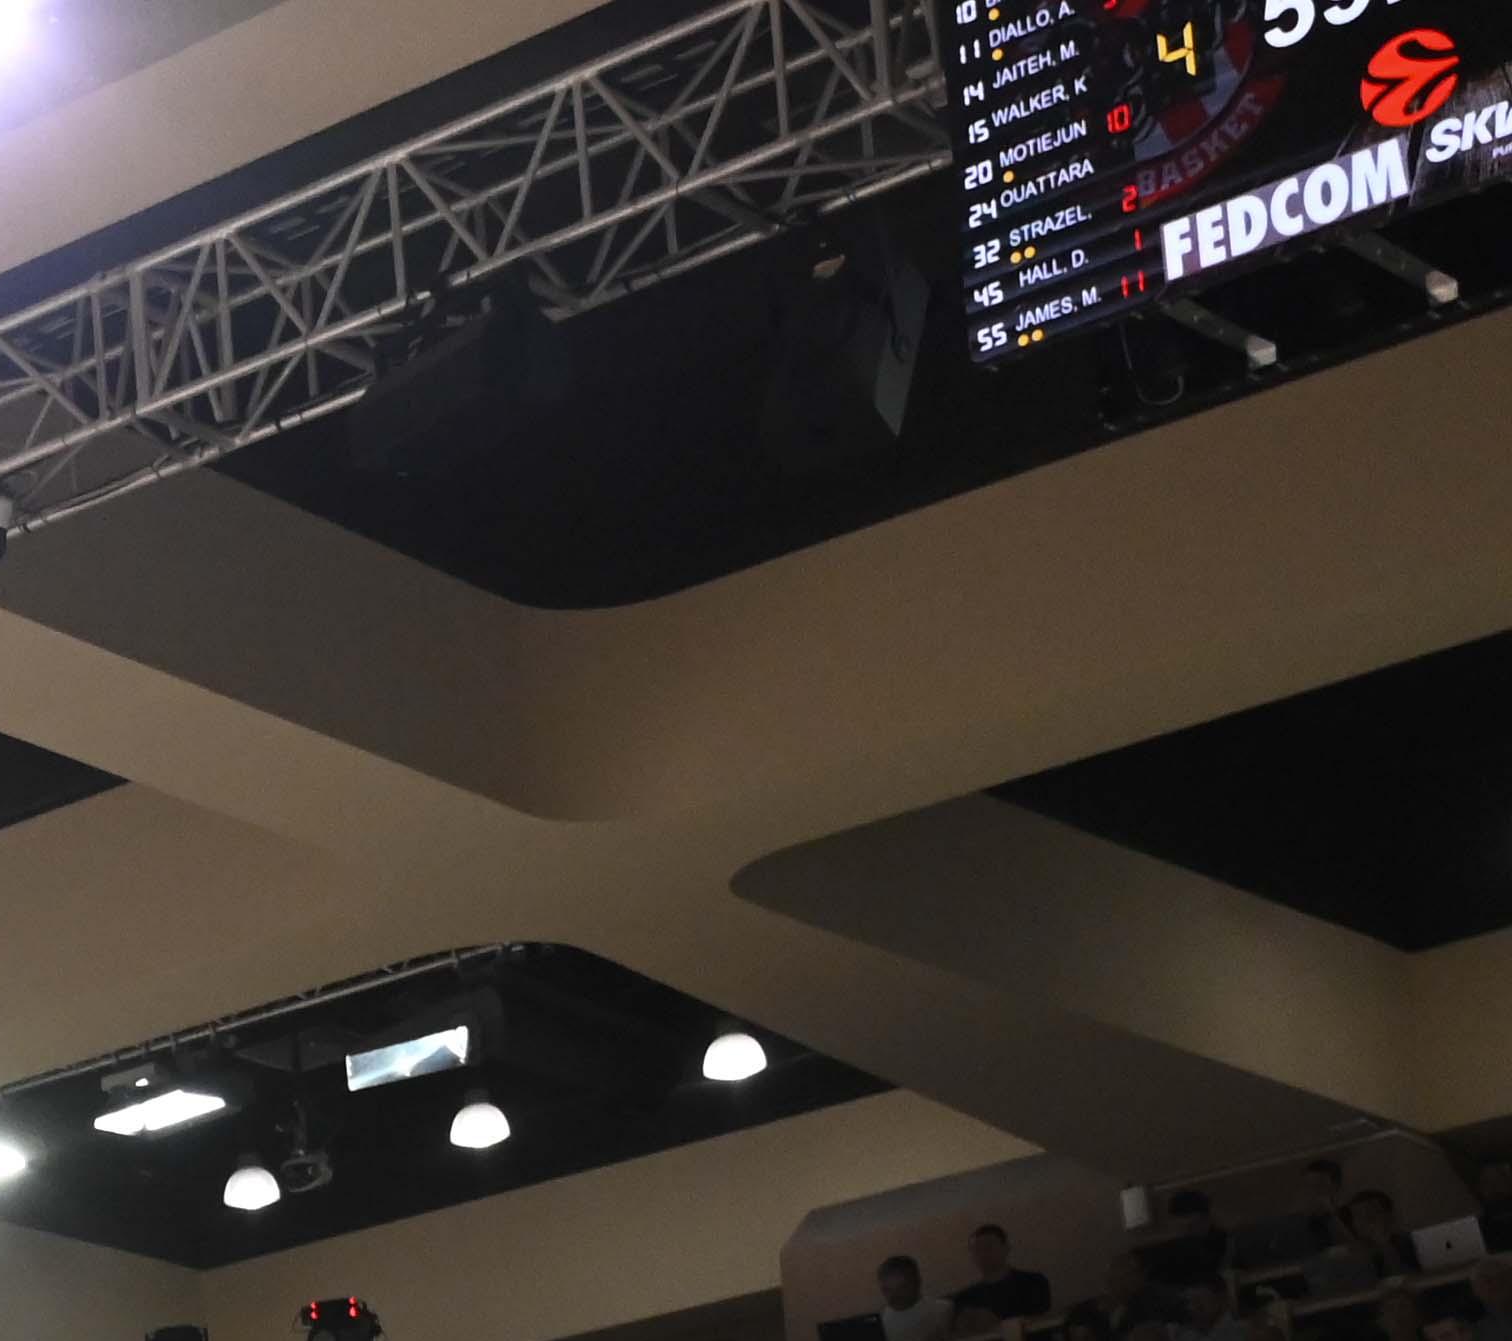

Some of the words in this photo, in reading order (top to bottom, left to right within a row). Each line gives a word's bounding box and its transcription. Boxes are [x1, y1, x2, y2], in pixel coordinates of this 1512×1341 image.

[1157, 21, 1196, 76] 4
[963, 80, 985, 106] 14
[968, 119, 990, 144] 15
[964, 159, 993, 190] 20
[999, 120, 1088, 168] MOTIEJUN
[968, 199, 998, 229] 24
[1000, 158, 1095, 208] OUATTARA
[1164, 138, 1410, 282] FEDCOM
[973, 239, 1001, 269] 32
[973, 281, 1004, 307] 45
[977, 322, 1007, 351] 55
